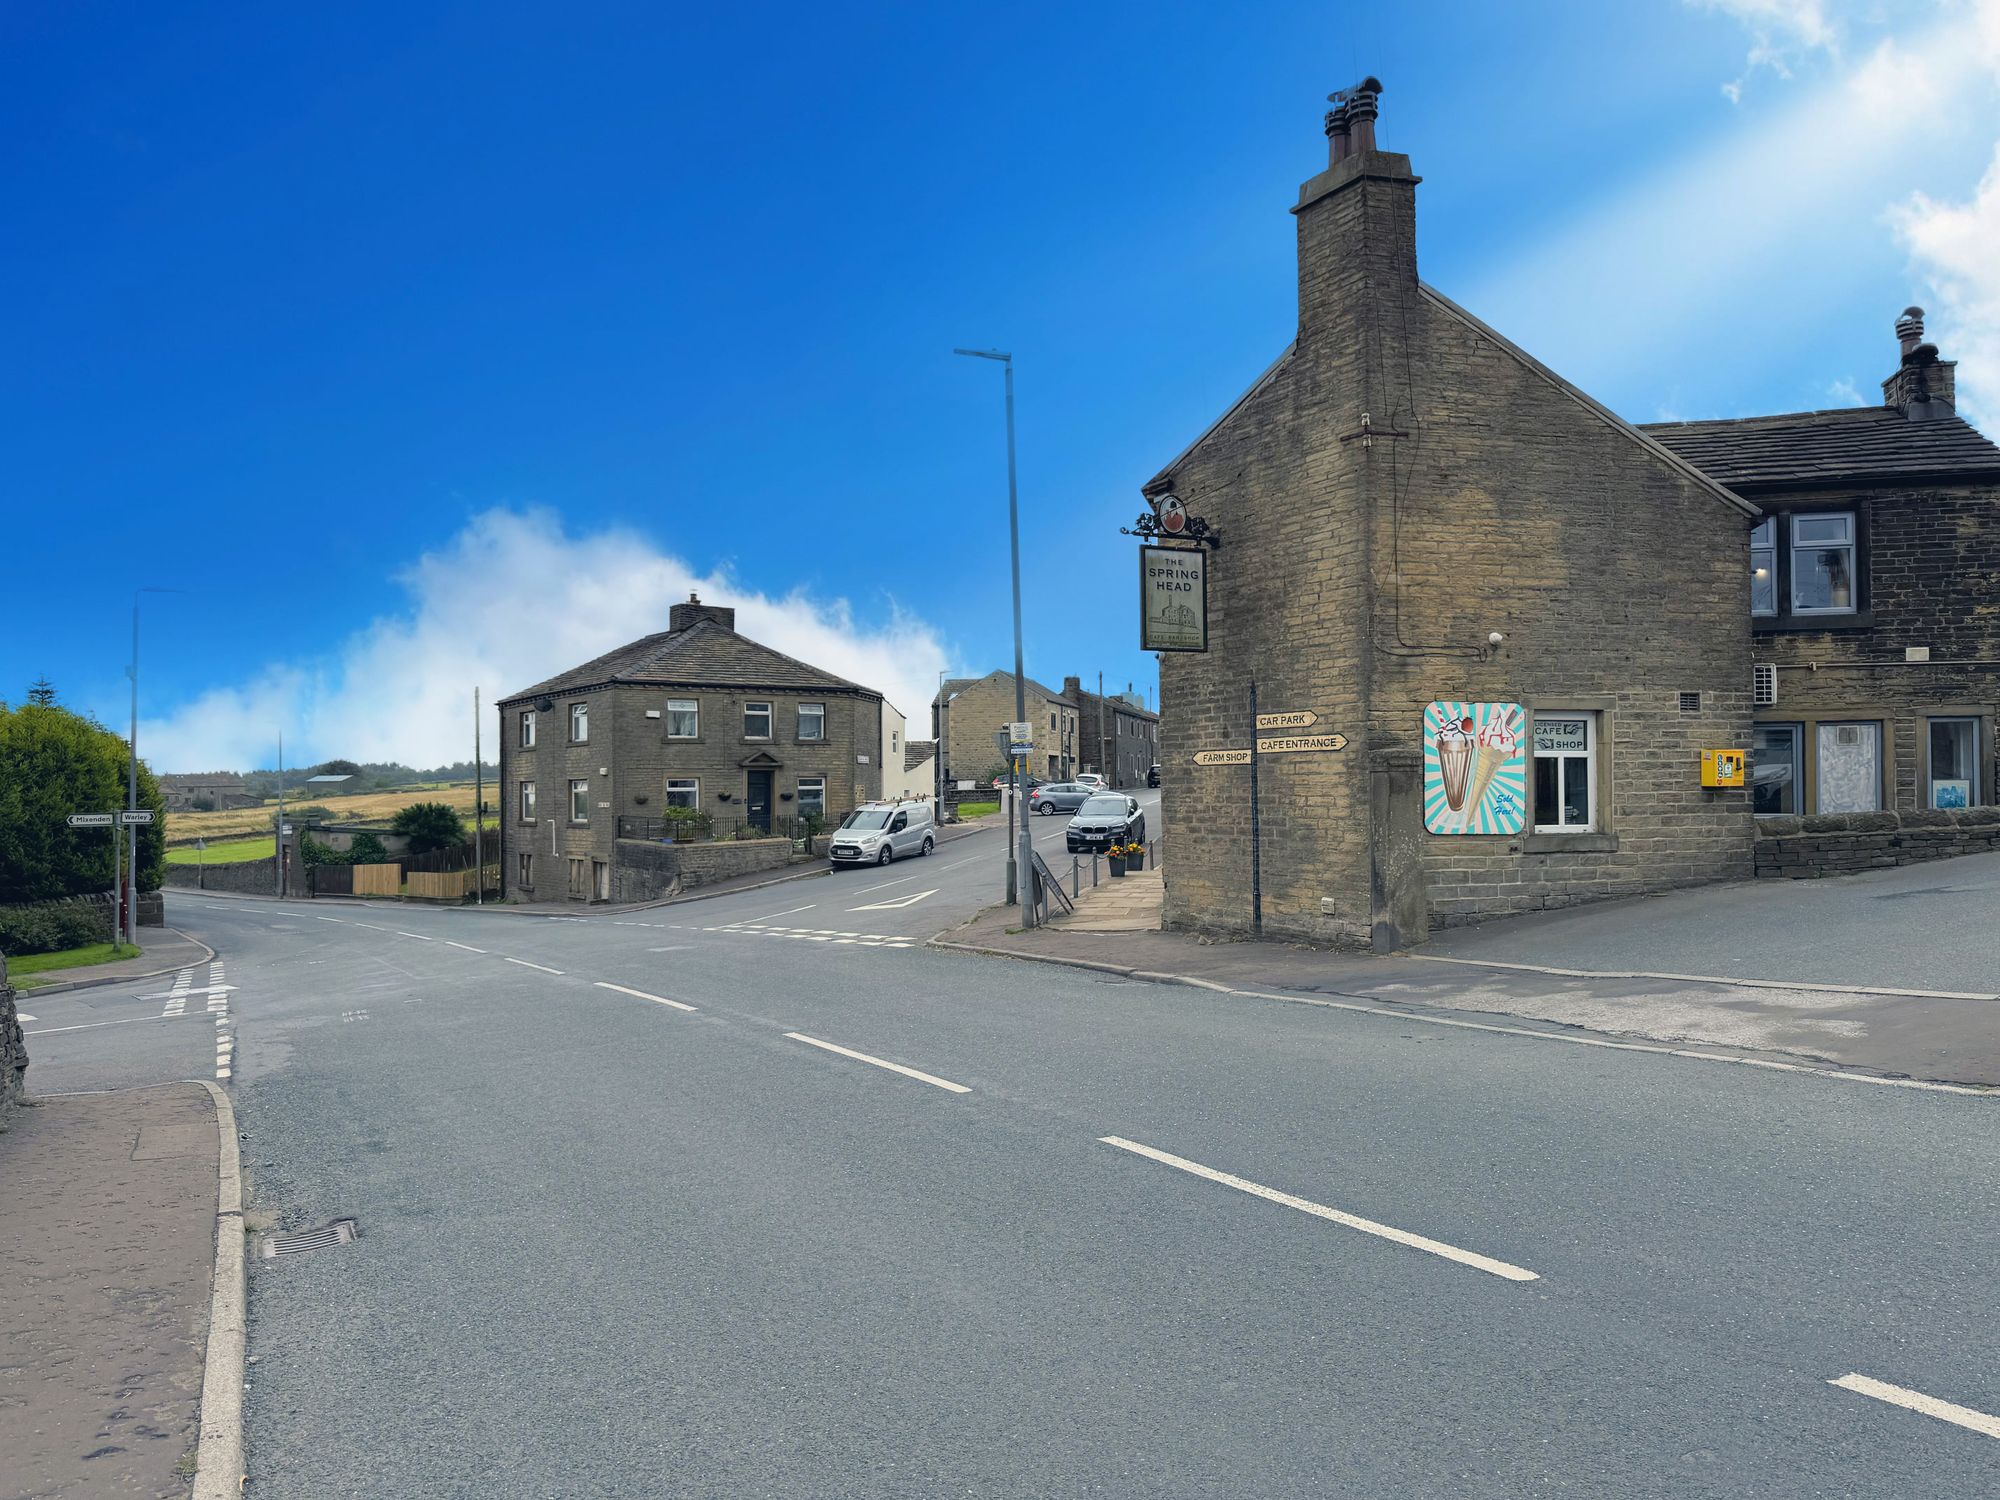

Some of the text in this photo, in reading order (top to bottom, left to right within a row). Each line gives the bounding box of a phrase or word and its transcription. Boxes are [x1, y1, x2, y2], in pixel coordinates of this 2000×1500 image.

[1165, 558, 1183, 566] THE
[1149, 568, 1199, 580] SPRING
[1156, 581, 1192, 592] HEAD
[1260, 715, 1305, 726] CAR PARK
[1535, 727, 1562, 735] CAFE
[1260, 738, 1337, 750] CAFE ENTRANCE
[1556, 741, 1583, 749] SHOP
[1203, 752, 1248, 762] FARM SHOP
[1496, 794, 1514, 803] Sold
